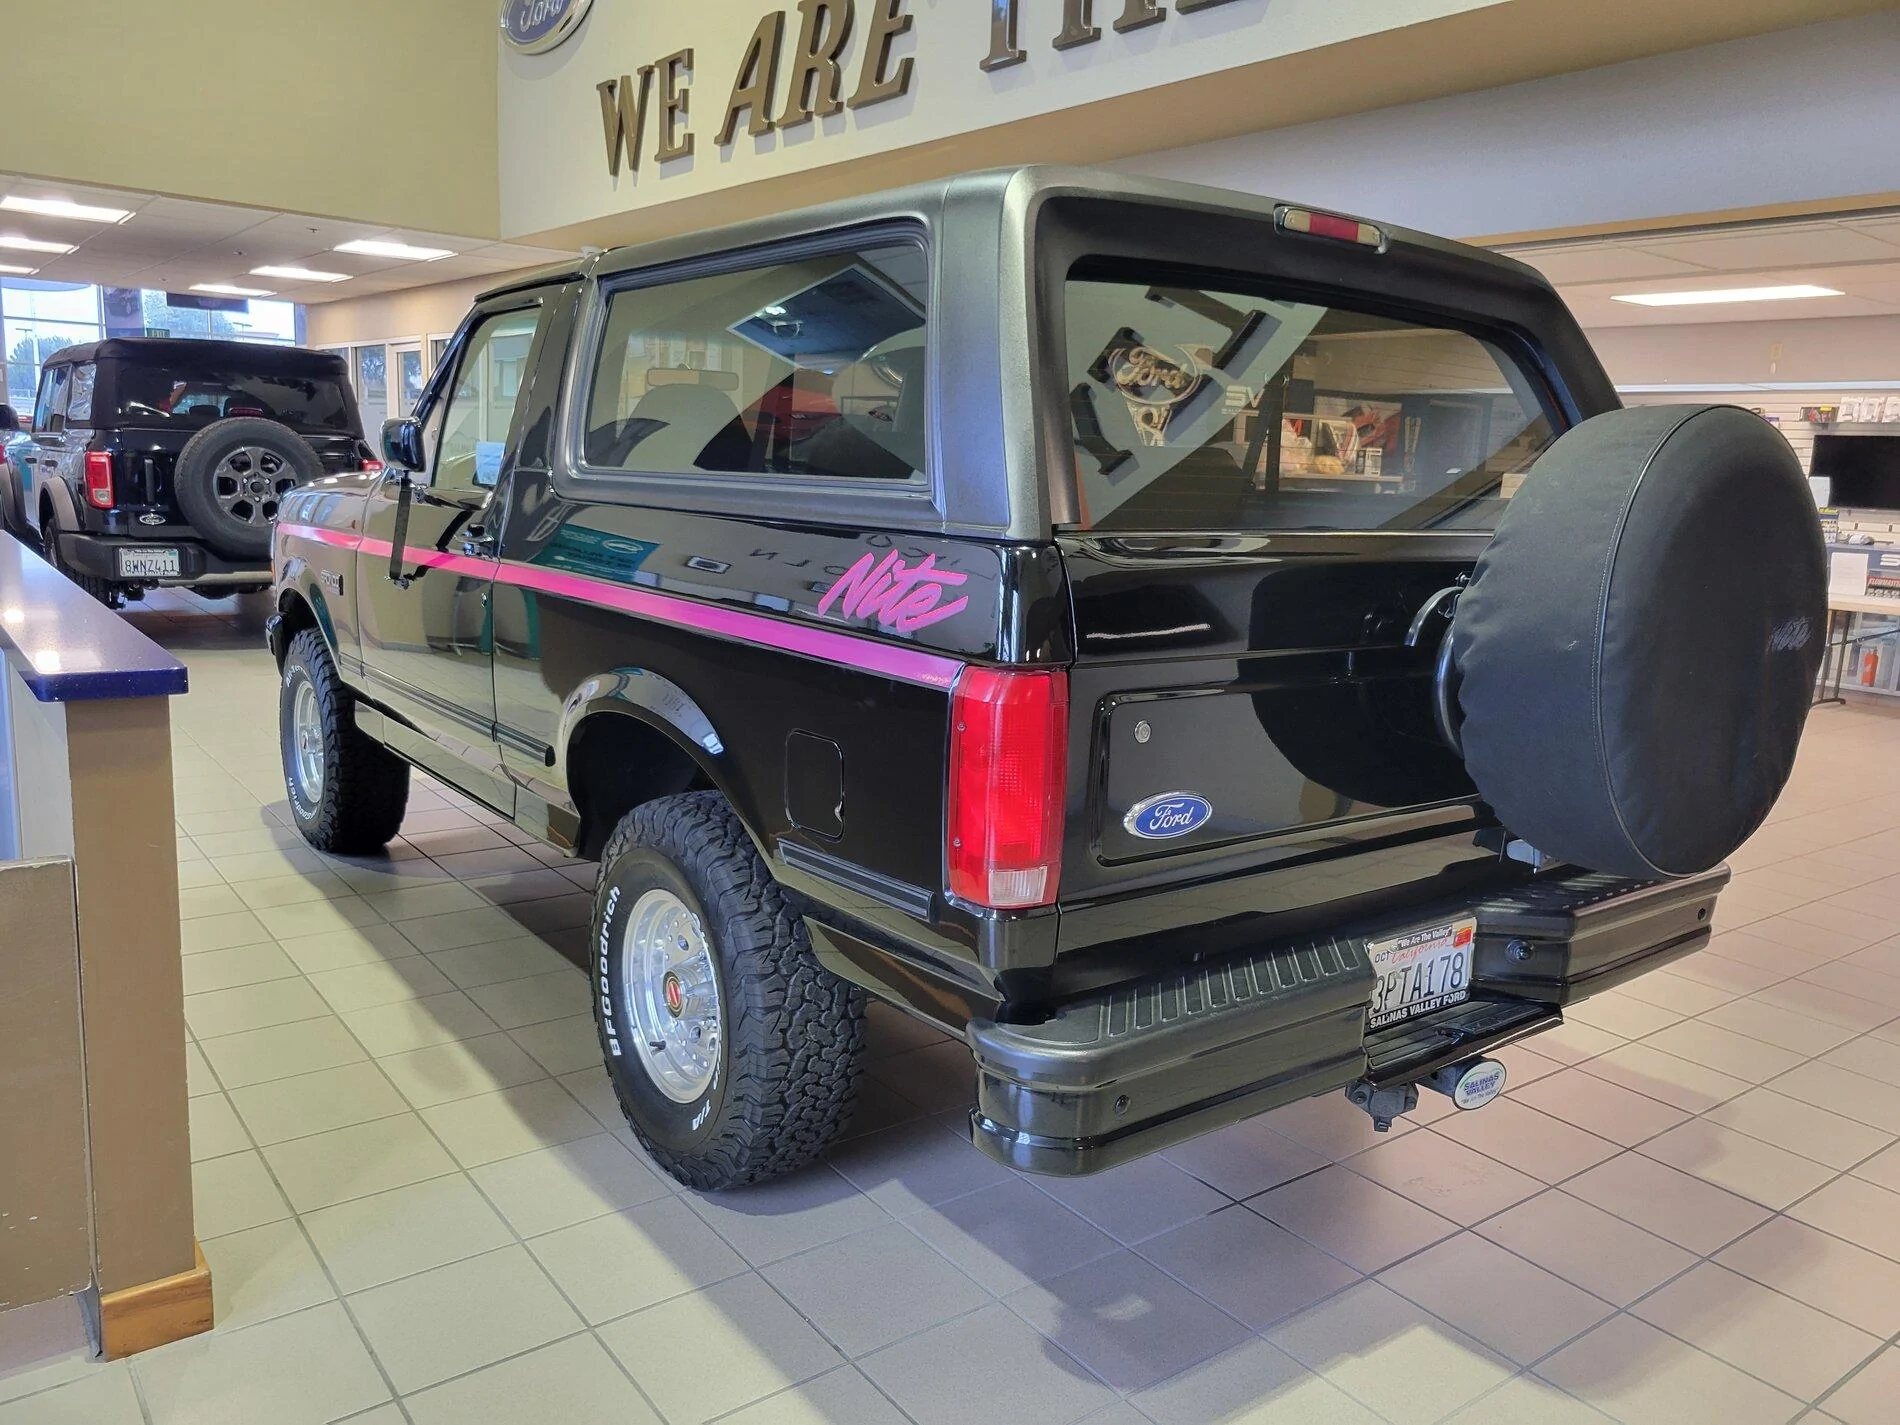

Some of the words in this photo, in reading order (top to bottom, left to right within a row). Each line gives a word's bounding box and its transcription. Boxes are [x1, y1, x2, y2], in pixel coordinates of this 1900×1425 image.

[596, 48, 695, 177] WE
[125, 559, 175, 573] 8WNZ411
[818, 549, 968, 633] Nite
[1149, 803, 1193, 830] Ford
[1421, 931, 1432, 942] The
[1375, 950, 1389, 963] OCT
[1391, 938, 1448, 965] California
[600, 885, 621, 1057] BFGoodrich
[1373, 952, 1464, 1014] 3PTA178
[1370, 1008, 1408, 1029] SALINAS
[1410, 997, 1441, 1016] VALLEY
[1443, 990, 1466, 1006] FORD
[1464, 1071, 1500, 1091] SALINAS
